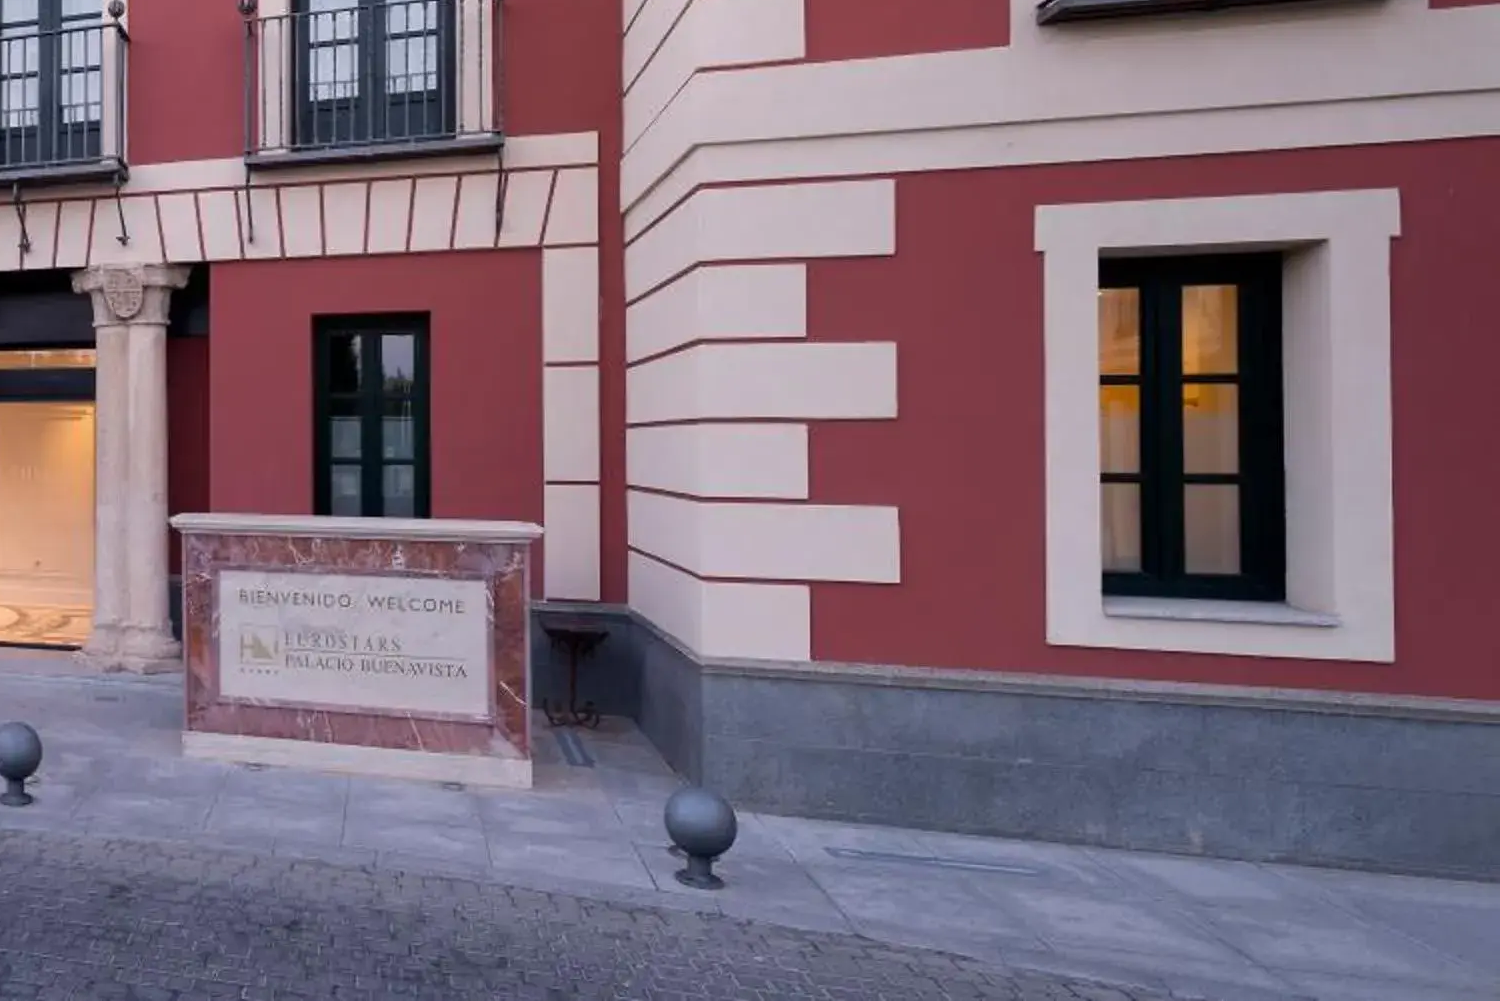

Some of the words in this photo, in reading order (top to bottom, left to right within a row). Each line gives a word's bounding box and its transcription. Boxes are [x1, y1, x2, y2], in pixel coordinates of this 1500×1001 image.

[367, 595, 465, 613] WELCOME
[284, 654, 354, 672] PALACIO
[360, 658, 468, 678] BUENAVISTA
